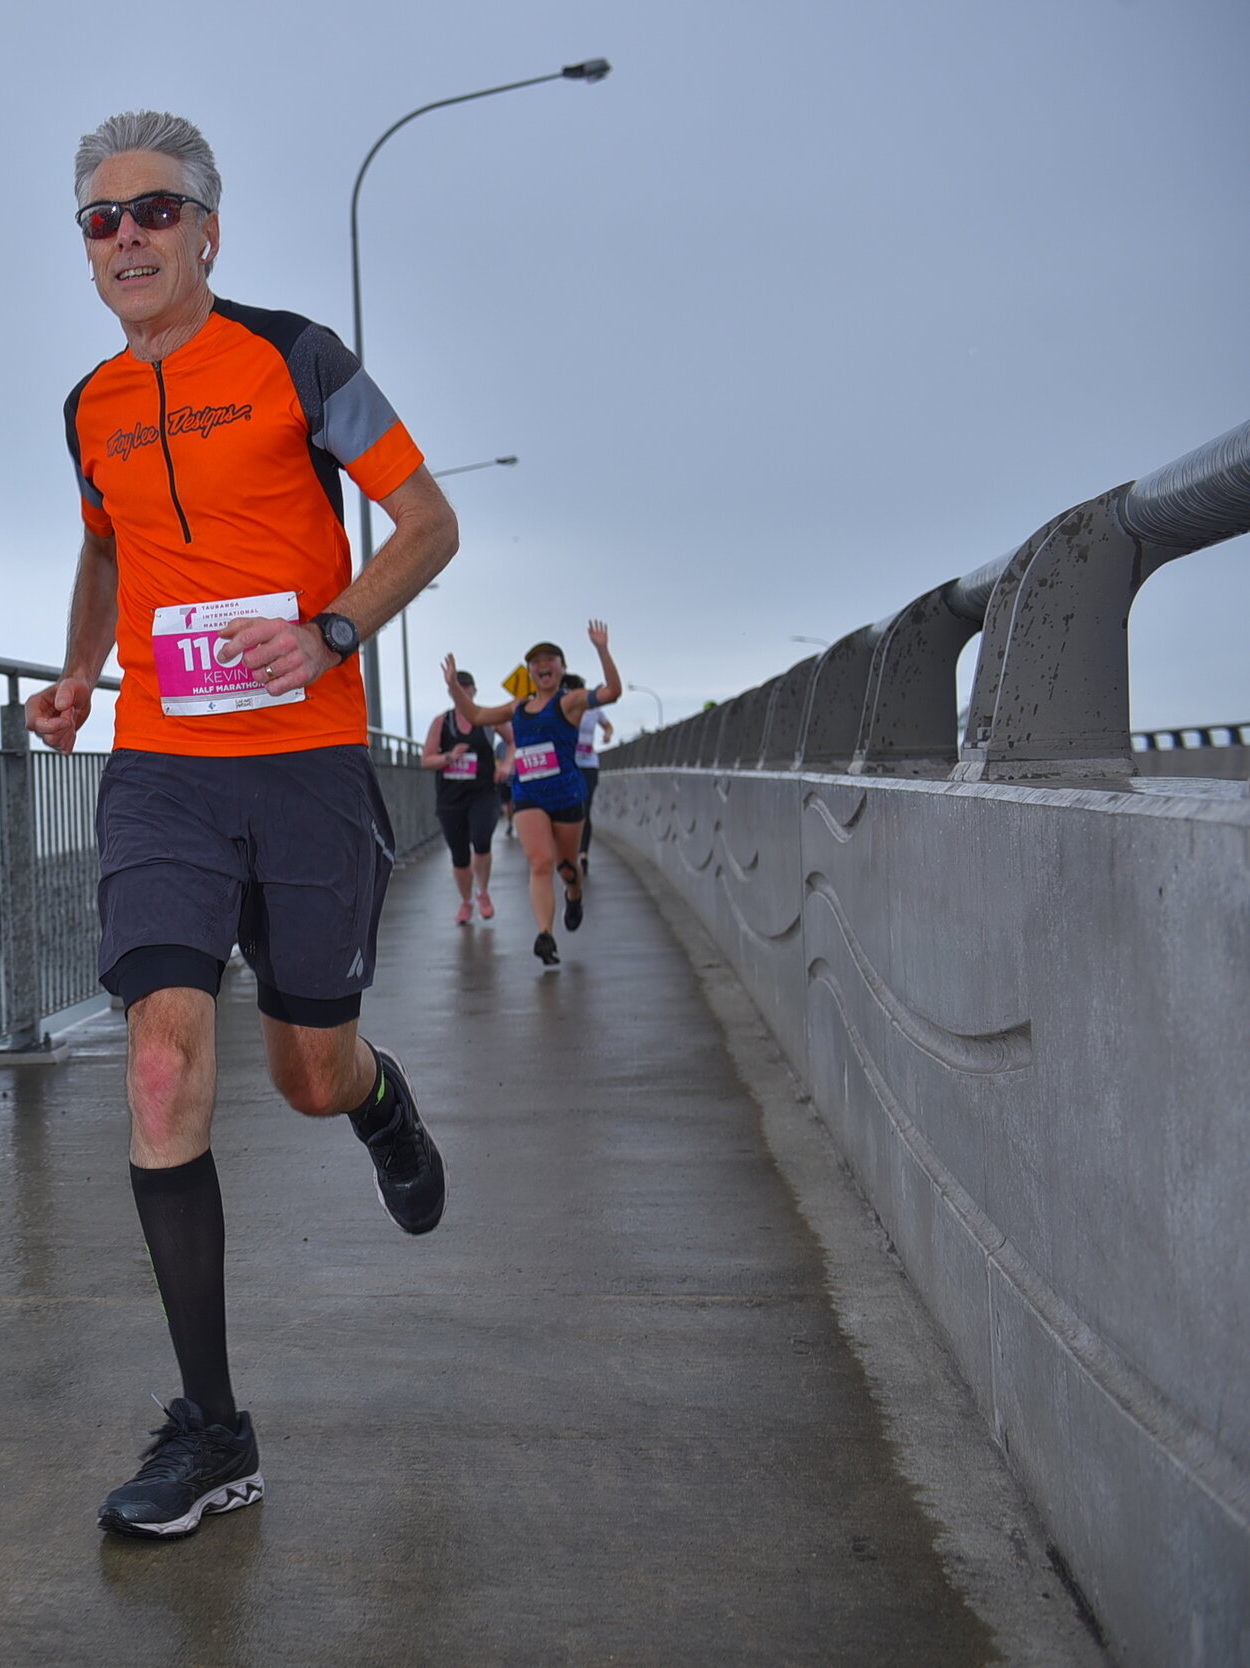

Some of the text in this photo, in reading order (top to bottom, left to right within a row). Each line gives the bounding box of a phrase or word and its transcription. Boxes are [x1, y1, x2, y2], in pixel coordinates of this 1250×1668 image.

[133, 422, 160, 449] Lee
[167, 403, 252, 439] Designs
[202, 602, 239, 611] TAURANGA
[202, 608, 259, 619] INTERNATIONAL
[203, 668, 249, 684] KEVIN
[192, 686, 215, 695] HALF
